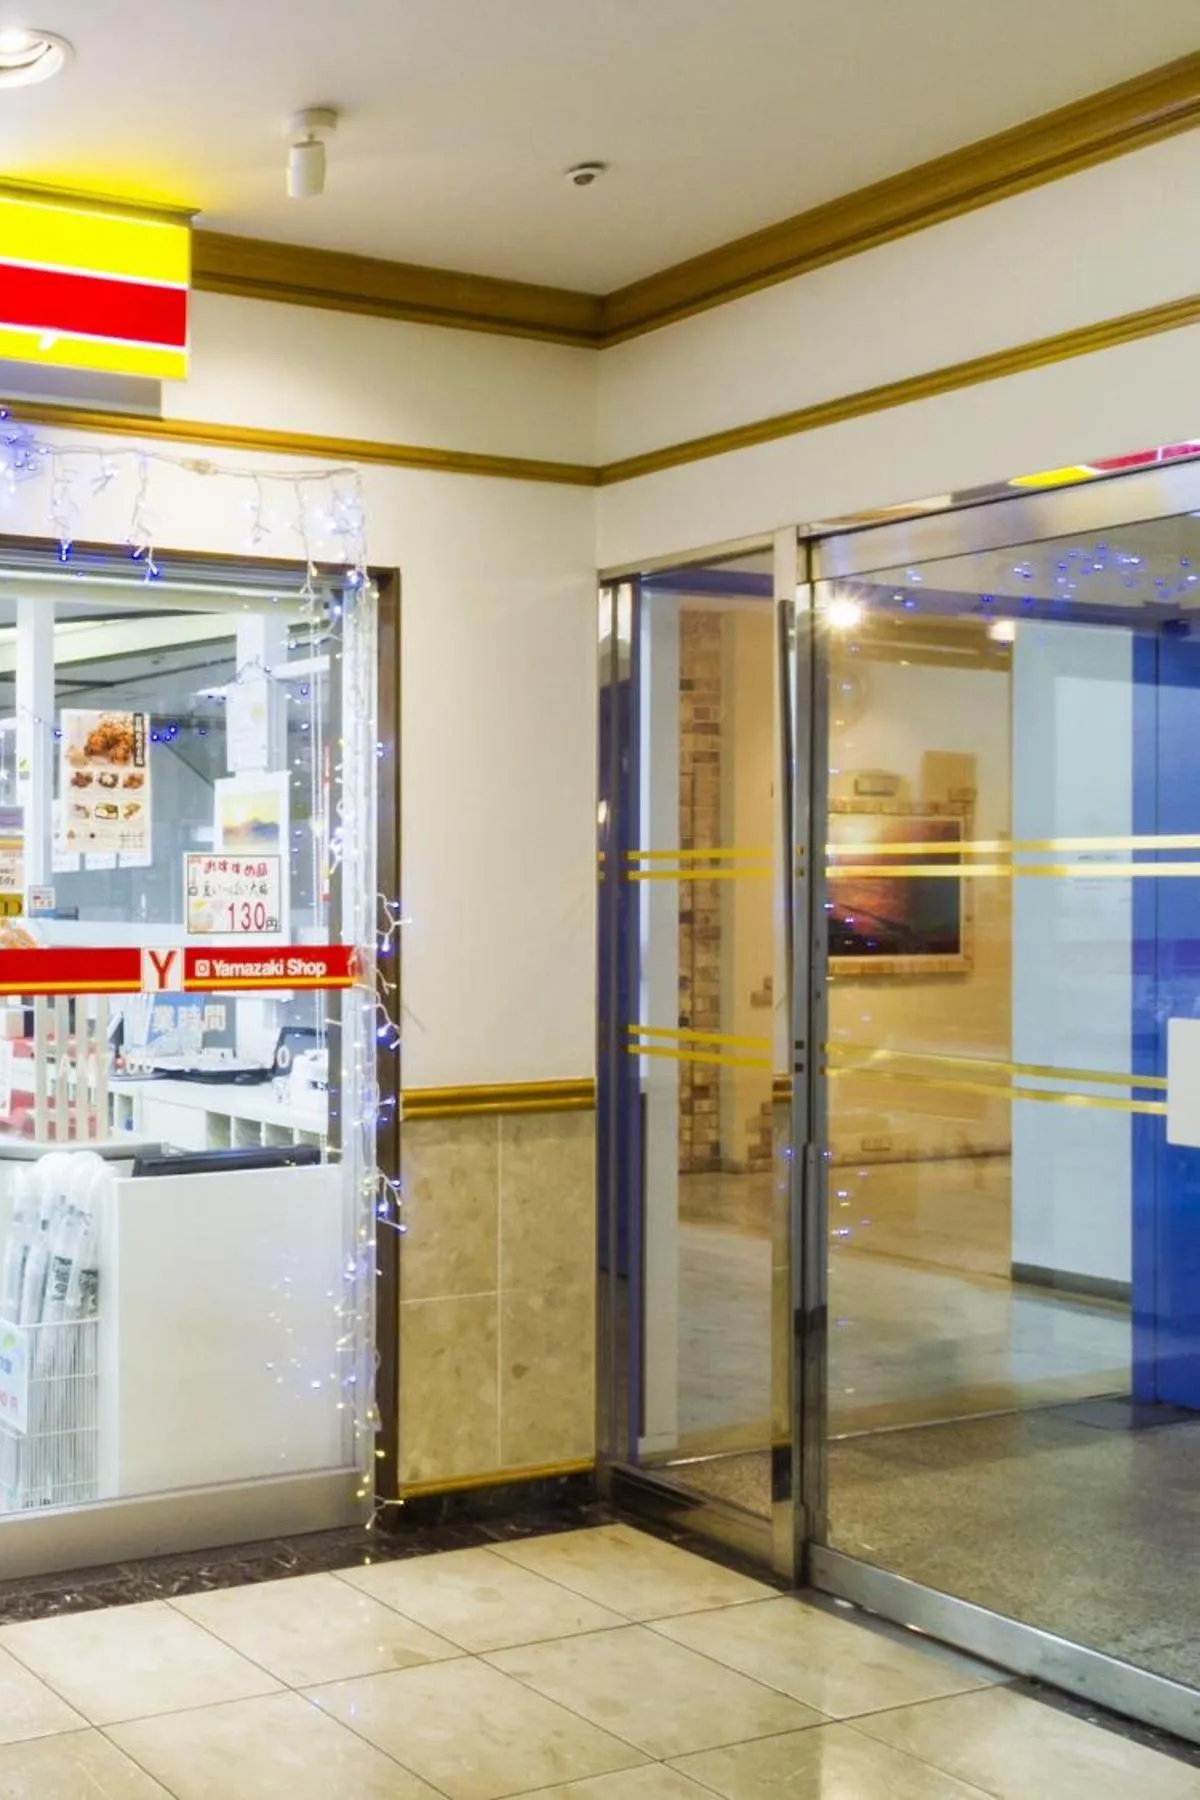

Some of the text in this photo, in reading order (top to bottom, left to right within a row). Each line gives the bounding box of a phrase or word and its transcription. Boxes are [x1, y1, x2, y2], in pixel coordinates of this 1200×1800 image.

[149, 950, 177, 989] Y
[212, 959, 327, 978] Yamazaki Shop
